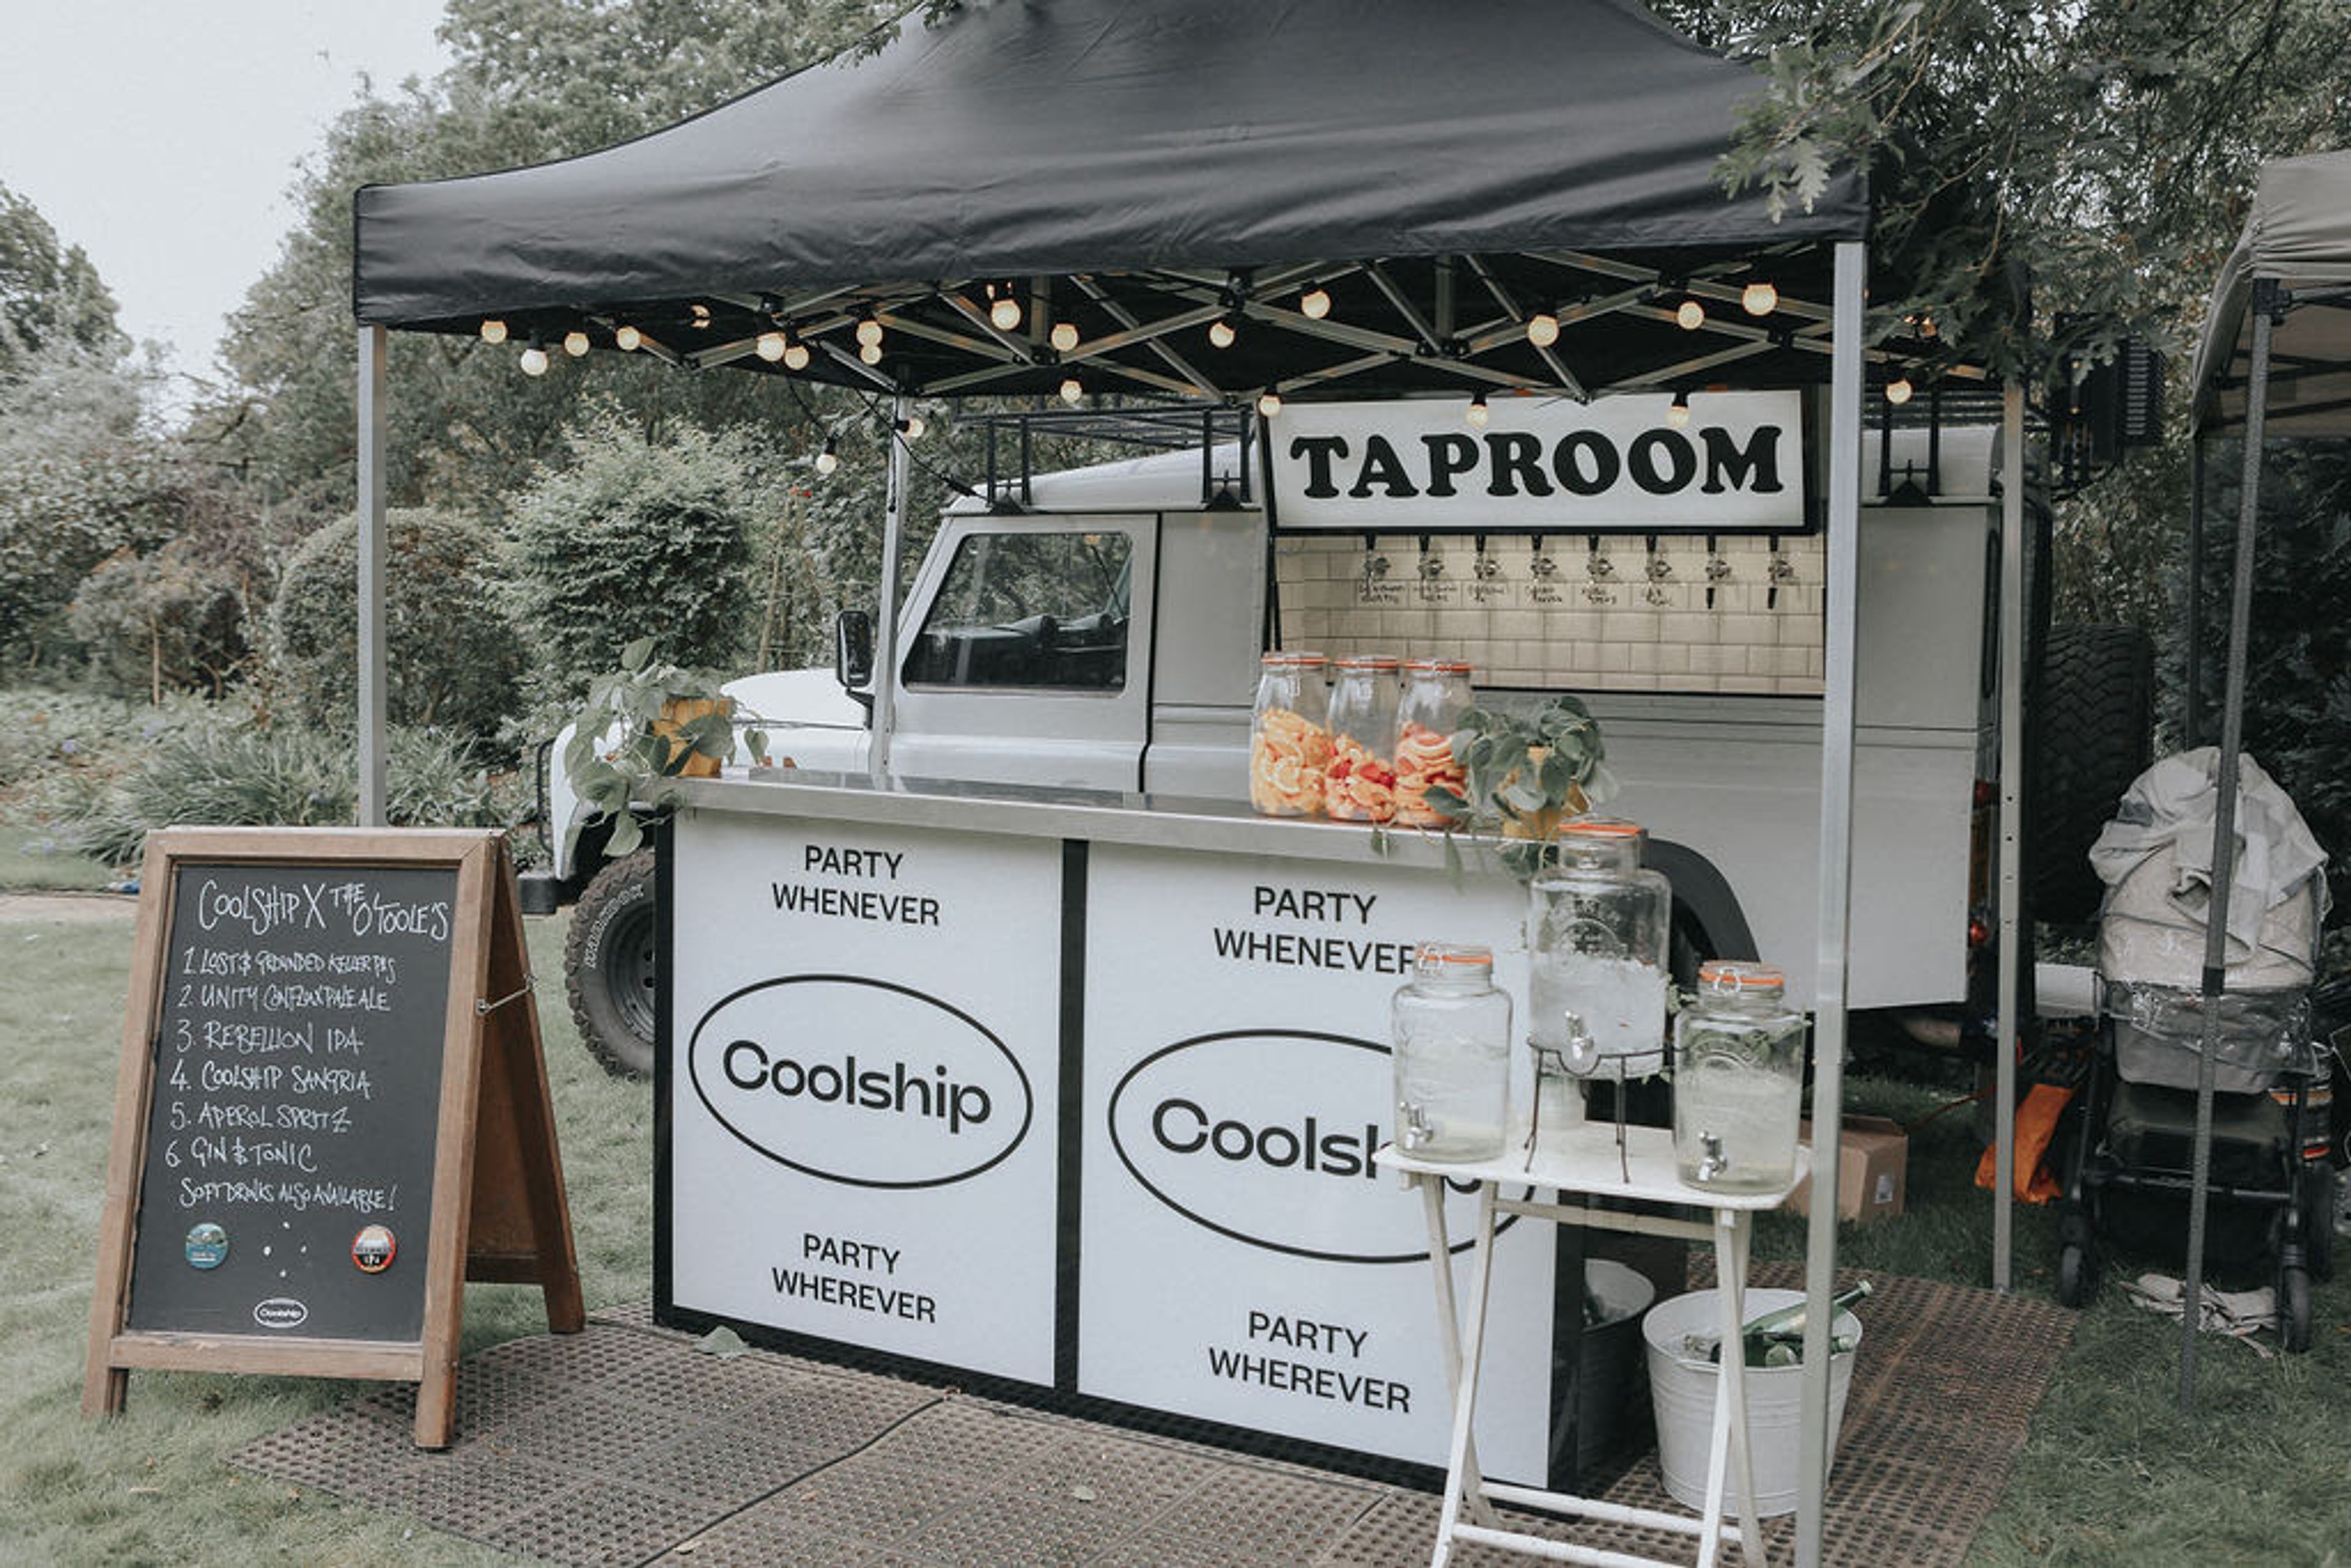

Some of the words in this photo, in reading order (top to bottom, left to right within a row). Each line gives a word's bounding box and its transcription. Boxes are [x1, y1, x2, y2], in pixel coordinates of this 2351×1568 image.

[1290, 426, 1784, 498] TAPROOM
[805, 846, 903, 879] PARTY
[329, 882, 366, 915] THE
[772, 883, 940, 926] WHENEVER
[1254, 887, 1376, 924] PARTY
[201, 984, 259, 1011] UNITY
[358, 985, 391, 1011] ALE
[203, 1019, 313, 1054] REBELLION
[327, 1026, 364, 1056] IPA
[170, 1058, 192, 1092] 4.
[291, 1065, 371, 1100] SANGRIA
[723, 1040, 992, 1135] Coolship
[170, 1101, 192, 1130] 5.
[198, 1101, 274, 1129] APEROL
[190, 1136, 227, 1168] GIN
[231, 1136, 249, 1166] &
[249, 1139, 318, 1172] TONIC
[278, 1182, 312, 1211] ALSO
[803, 1234, 900, 1274] PARTY
[772, 1267, 936, 1322] WHEREVER
[1248, 1310, 1368, 1358] PARTY
[1209, 1348, 1411, 1413] WHEREVER
